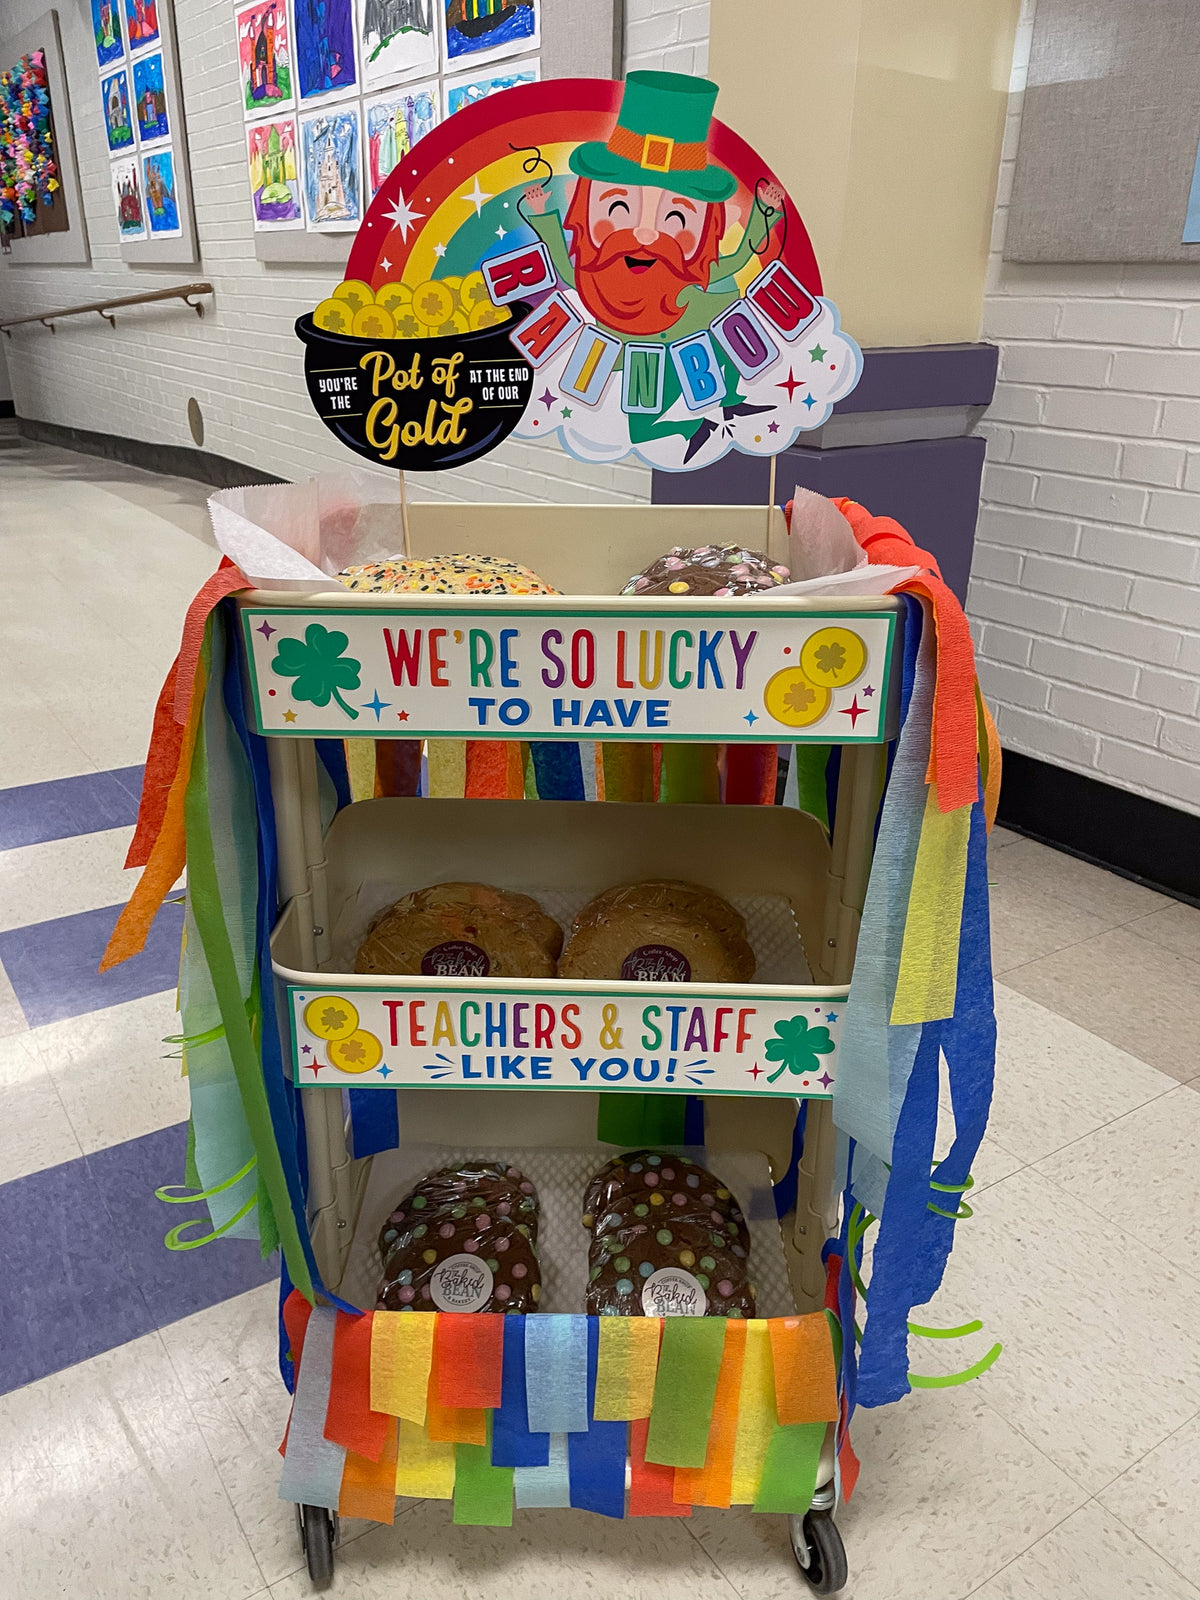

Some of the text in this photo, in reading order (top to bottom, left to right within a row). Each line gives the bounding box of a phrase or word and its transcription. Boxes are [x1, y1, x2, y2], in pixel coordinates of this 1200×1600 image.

[488, 249, 814, 409] RAINBOW
[319, 376, 358, 393] YOU'RE
[359, 351, 465, 398] Pot of
[469, 367, 529, 384] AT THE END
[330, 395, 352, 410] THE
[482, 385, 519, 401] OF OUR
[365, 397, 473, 461] Gold
[383, 628, 759, 690] WE'RE SO LUCKY
[469, 698, 670, 728] TO HAVE
[436, 964, 484, 976] BEAN
[382, 1000, 757, 1054] TEACHERS & STAFF
[462, 1054, 678, 1083] LIKE YOU!
[442, 1283, 483, 1299] BEAN
[656, 1300, 696, 1316] BEAN
